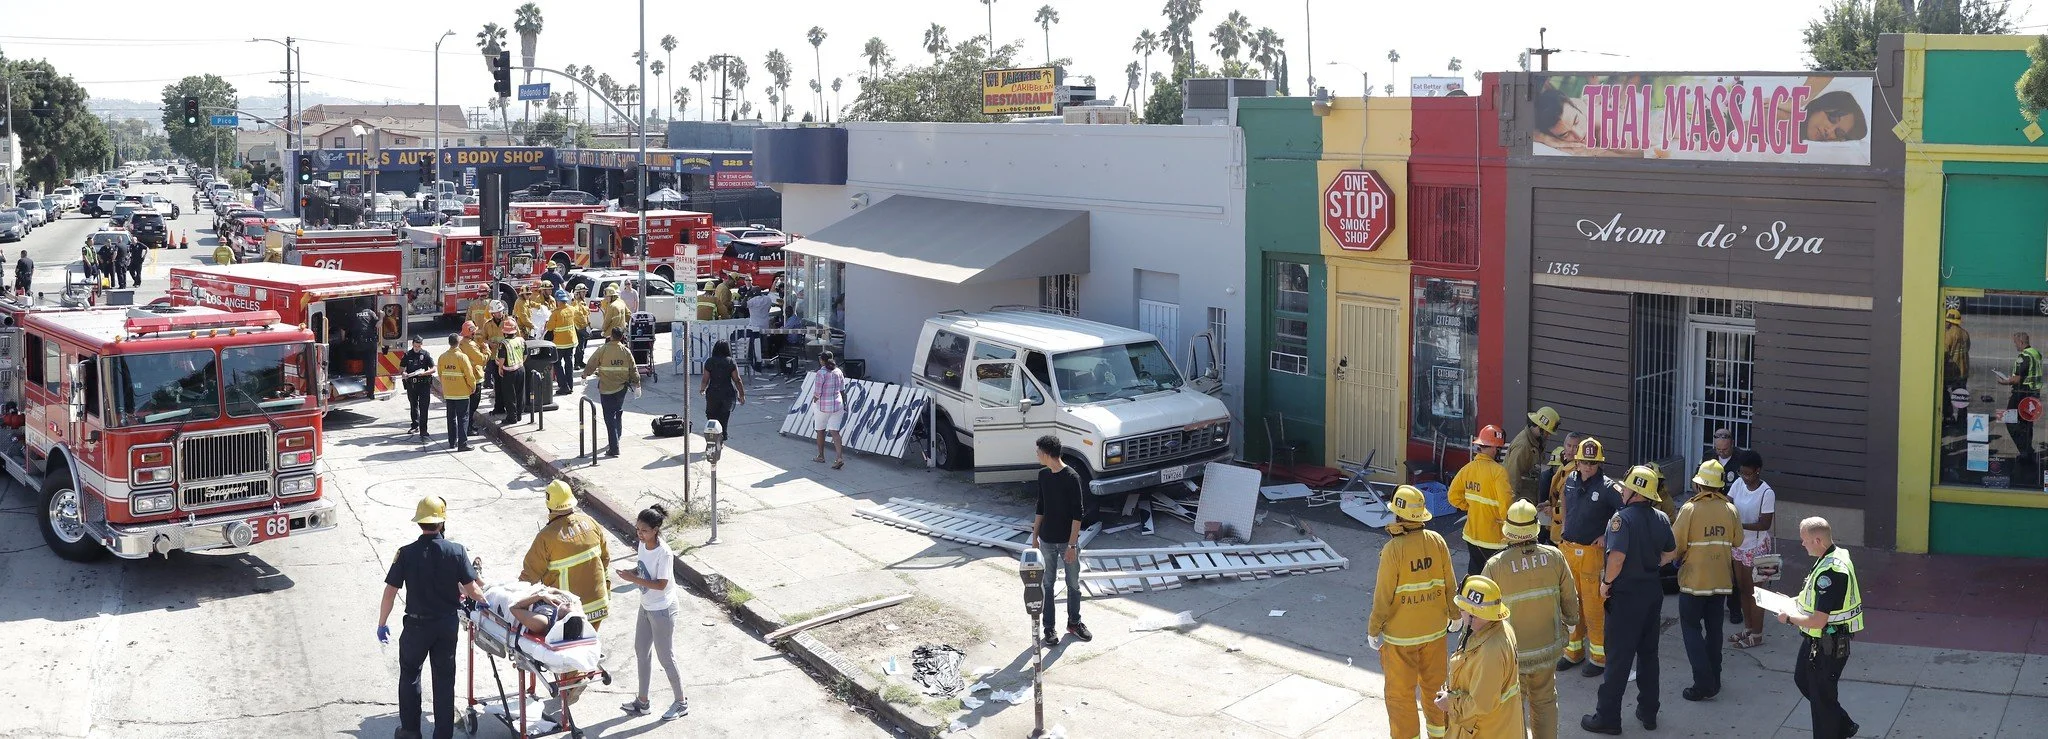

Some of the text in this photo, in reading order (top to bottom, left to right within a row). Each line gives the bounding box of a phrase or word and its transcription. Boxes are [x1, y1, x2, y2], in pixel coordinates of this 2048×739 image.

[520, 87, 541, 98] Redondo
[1011, 84, 1054, 93] CARIBBEAN
[985, 92, 1054, 107] RESTAURANT
[1582, 84, 1811, 154] THAI MASSAGE
[346, 151, 390, 166] TIRS
[443, 152, 453, 165] &
[457, 151, 499, 164] BODY
[503, 150, 544, 164] SHOP
[562, 152, 578, 164] TIRES
[1344, 175, 1368, 191] ONE
[1329, 190, 1384, 219] STOP
[1340, 218, 1371, 231] SMOKE
[501, 236, 517, 244] PICO
[696, 230, 709, 239] 829
[1345, 231, 1369, 244] SHOP
[1576, 213, 1666, 245] Arom
[1755, 220, 1825, 260] Spa
[675, 244, 685, 255] NO
[676, 256, 696, 265] PARKING
[1546, 261, 1580, 276] 1365
[676, 284, 682, 293] 2
[206, 294, 261, 312] LOS ANGELES
[1971, 418, 1984, 432] A
[1585, 447, 1595, 455] 61
[1465, 480, 1481, 492] LAFD
[1635, 477, 1646, 487] 61
[205, 485, 249, 500] Seagrave
[1396, 499, 1404, 508] 61
[249, 516, 288, 538] E 68
[559, 520, 590, 541] LAFD
[1704, 526, 1726, 537] LAFD
[1510, 553, 1549, 573] LAFD
[1468, 590, 1482, 604] 43
